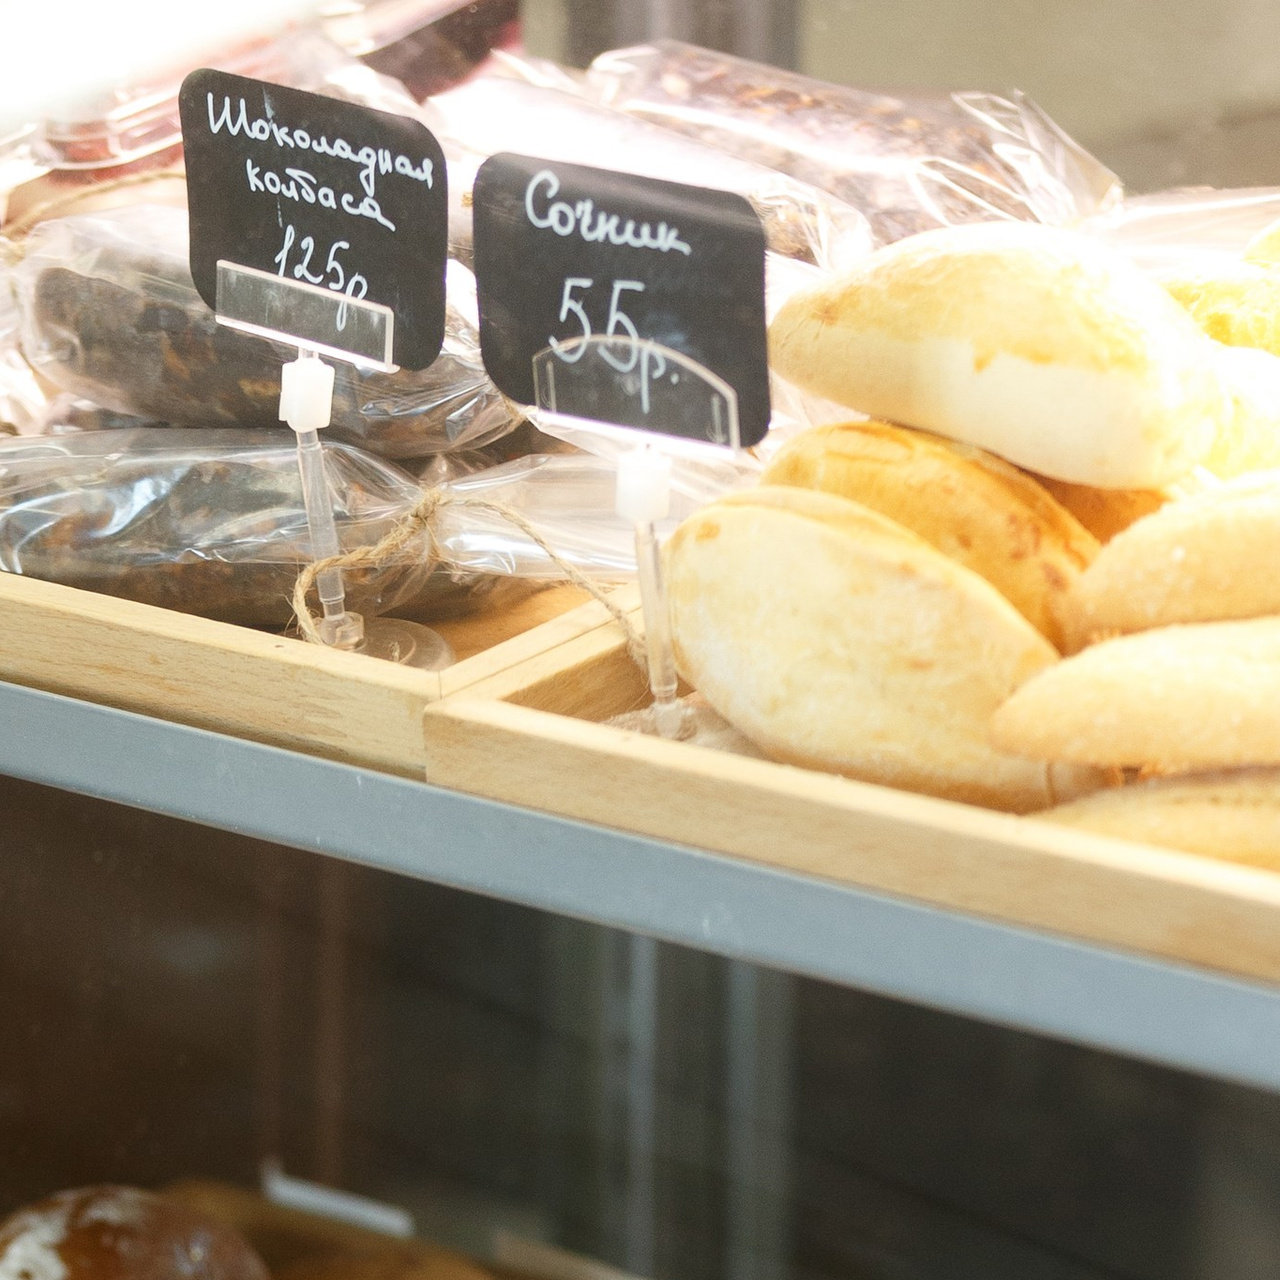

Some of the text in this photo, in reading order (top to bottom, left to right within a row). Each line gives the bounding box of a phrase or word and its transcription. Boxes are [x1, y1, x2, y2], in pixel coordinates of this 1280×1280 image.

[206, 91, 434, 198] Шоколадная
[245, 158, 397, 233] колбаса
[524, 168, 693, 257] Сочник
